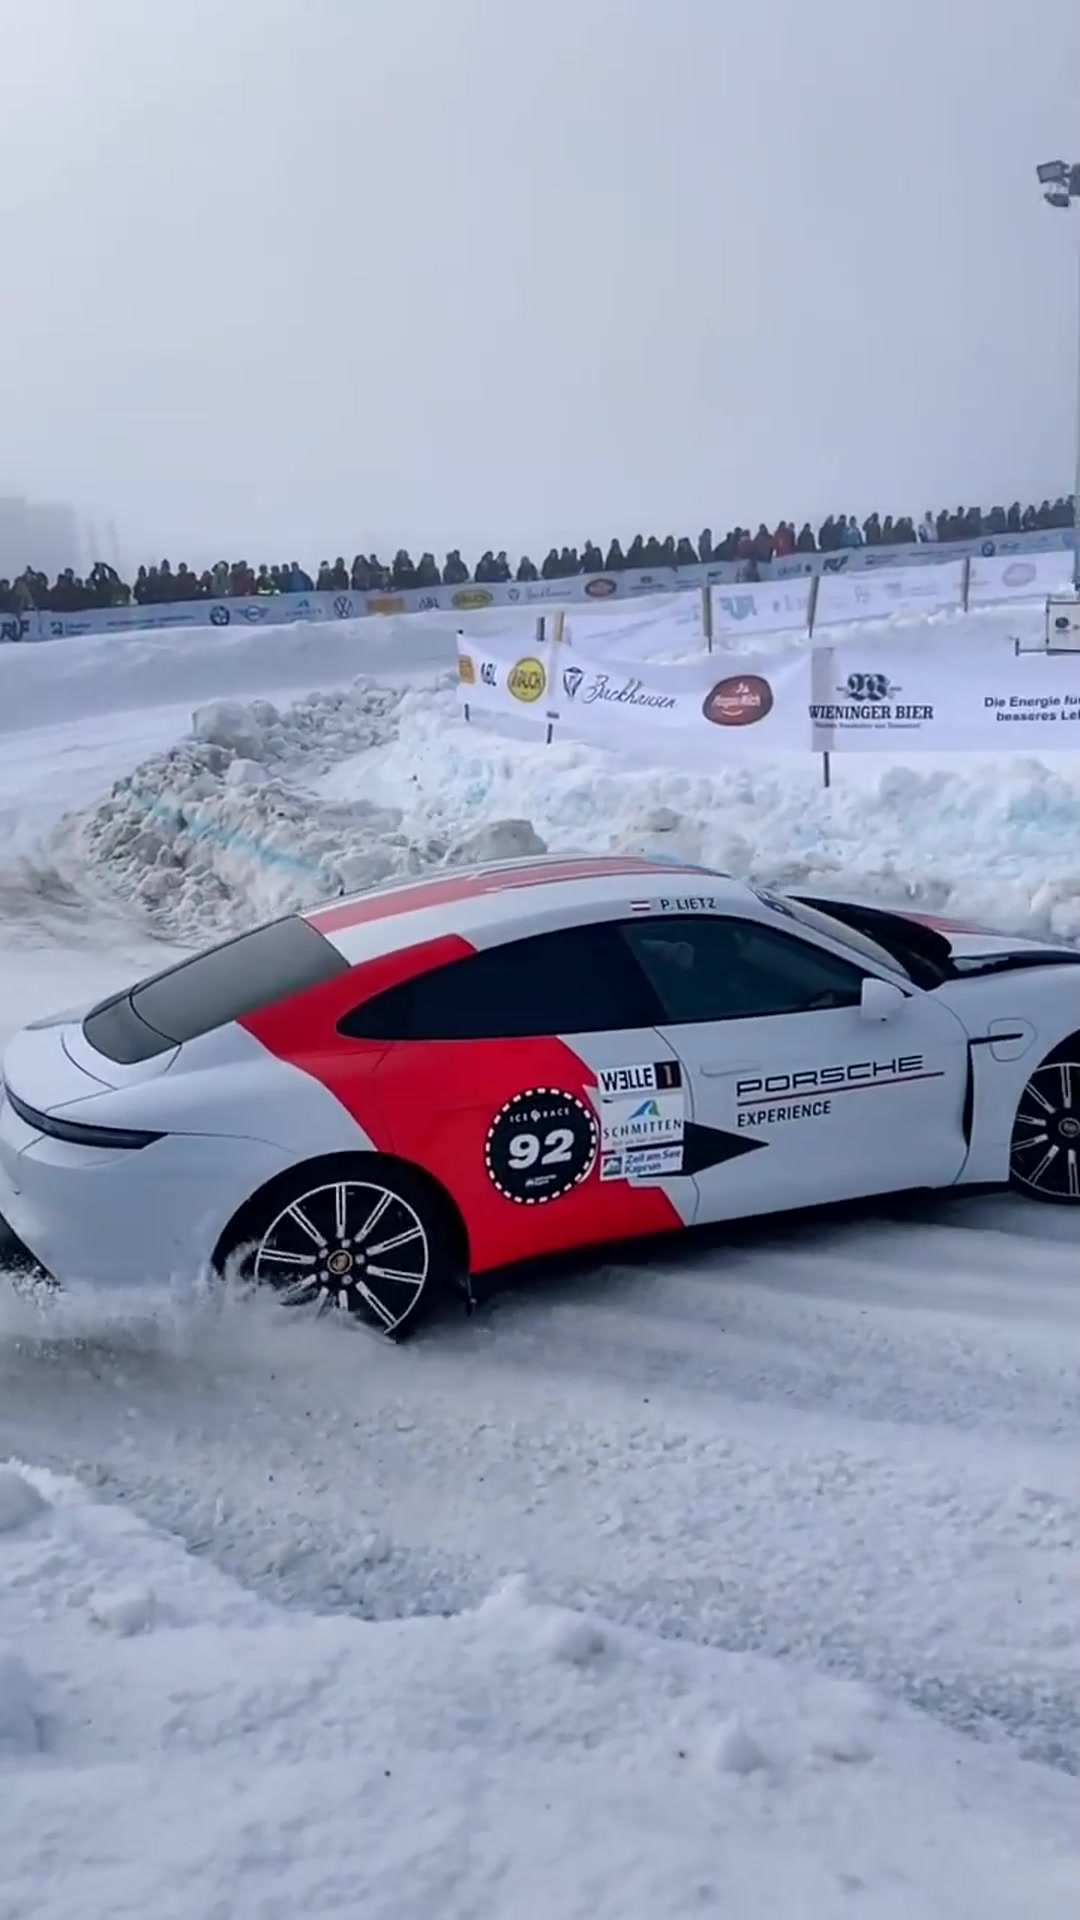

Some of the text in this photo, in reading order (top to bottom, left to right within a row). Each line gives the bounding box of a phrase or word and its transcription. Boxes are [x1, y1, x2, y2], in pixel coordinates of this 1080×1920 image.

[984, 696, 1006, 708] Die
[1009, 695, 1061, 709] Energie
[808, 705, 934, 720] WIENINGER BIER
[996, 711, 1057, 721] besseres
[660, 897, 717, 911] P. LIETZ
[736, 1054, 924, 1097] PORSCHE
[510, 1106, 571, 1123] ICE RACE
[737, 1100, 832, 1128] EXPERIENCE
[603, 1118, 682, 1139] SCHMITTEN
[508, 1128, 575, 1170] 92
